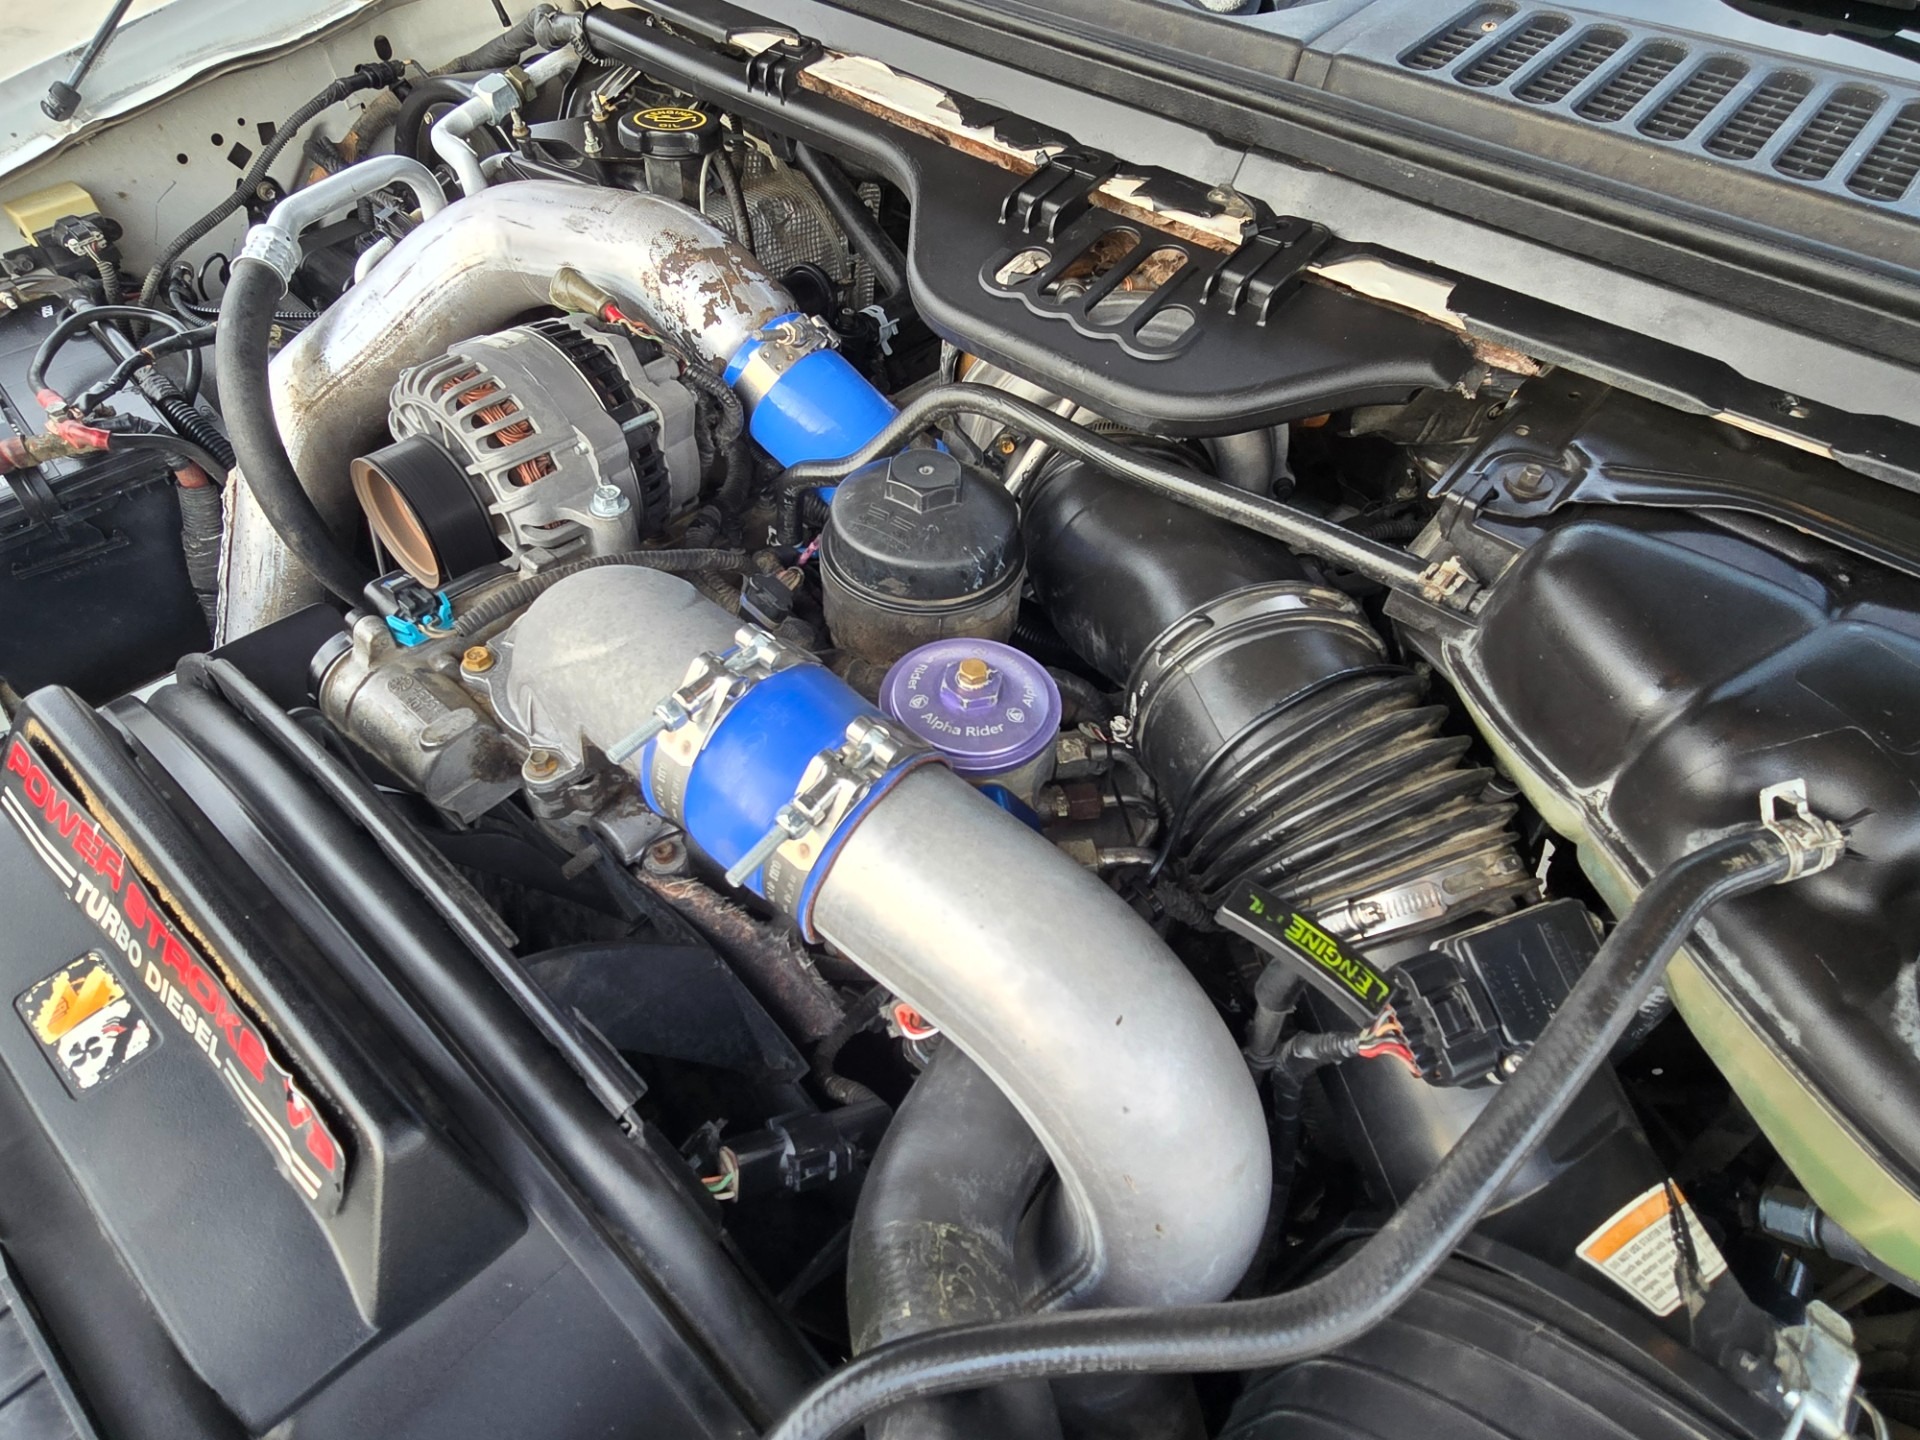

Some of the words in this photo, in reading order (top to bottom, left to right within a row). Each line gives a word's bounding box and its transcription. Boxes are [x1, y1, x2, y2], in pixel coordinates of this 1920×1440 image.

[907, 664, 928, 690] Rider
[921, 712, 961, 736] Alpha
[965, 723, 1004, 737] Rider
[7, 740, 127, 890] POWER
[122, 880, 266, 1083] STROKE
[73, 873, 143, 969] TURBO
[144, 960, 222, 1069] DIESEL
[1284, 918, 1373, 995] ENGINE
